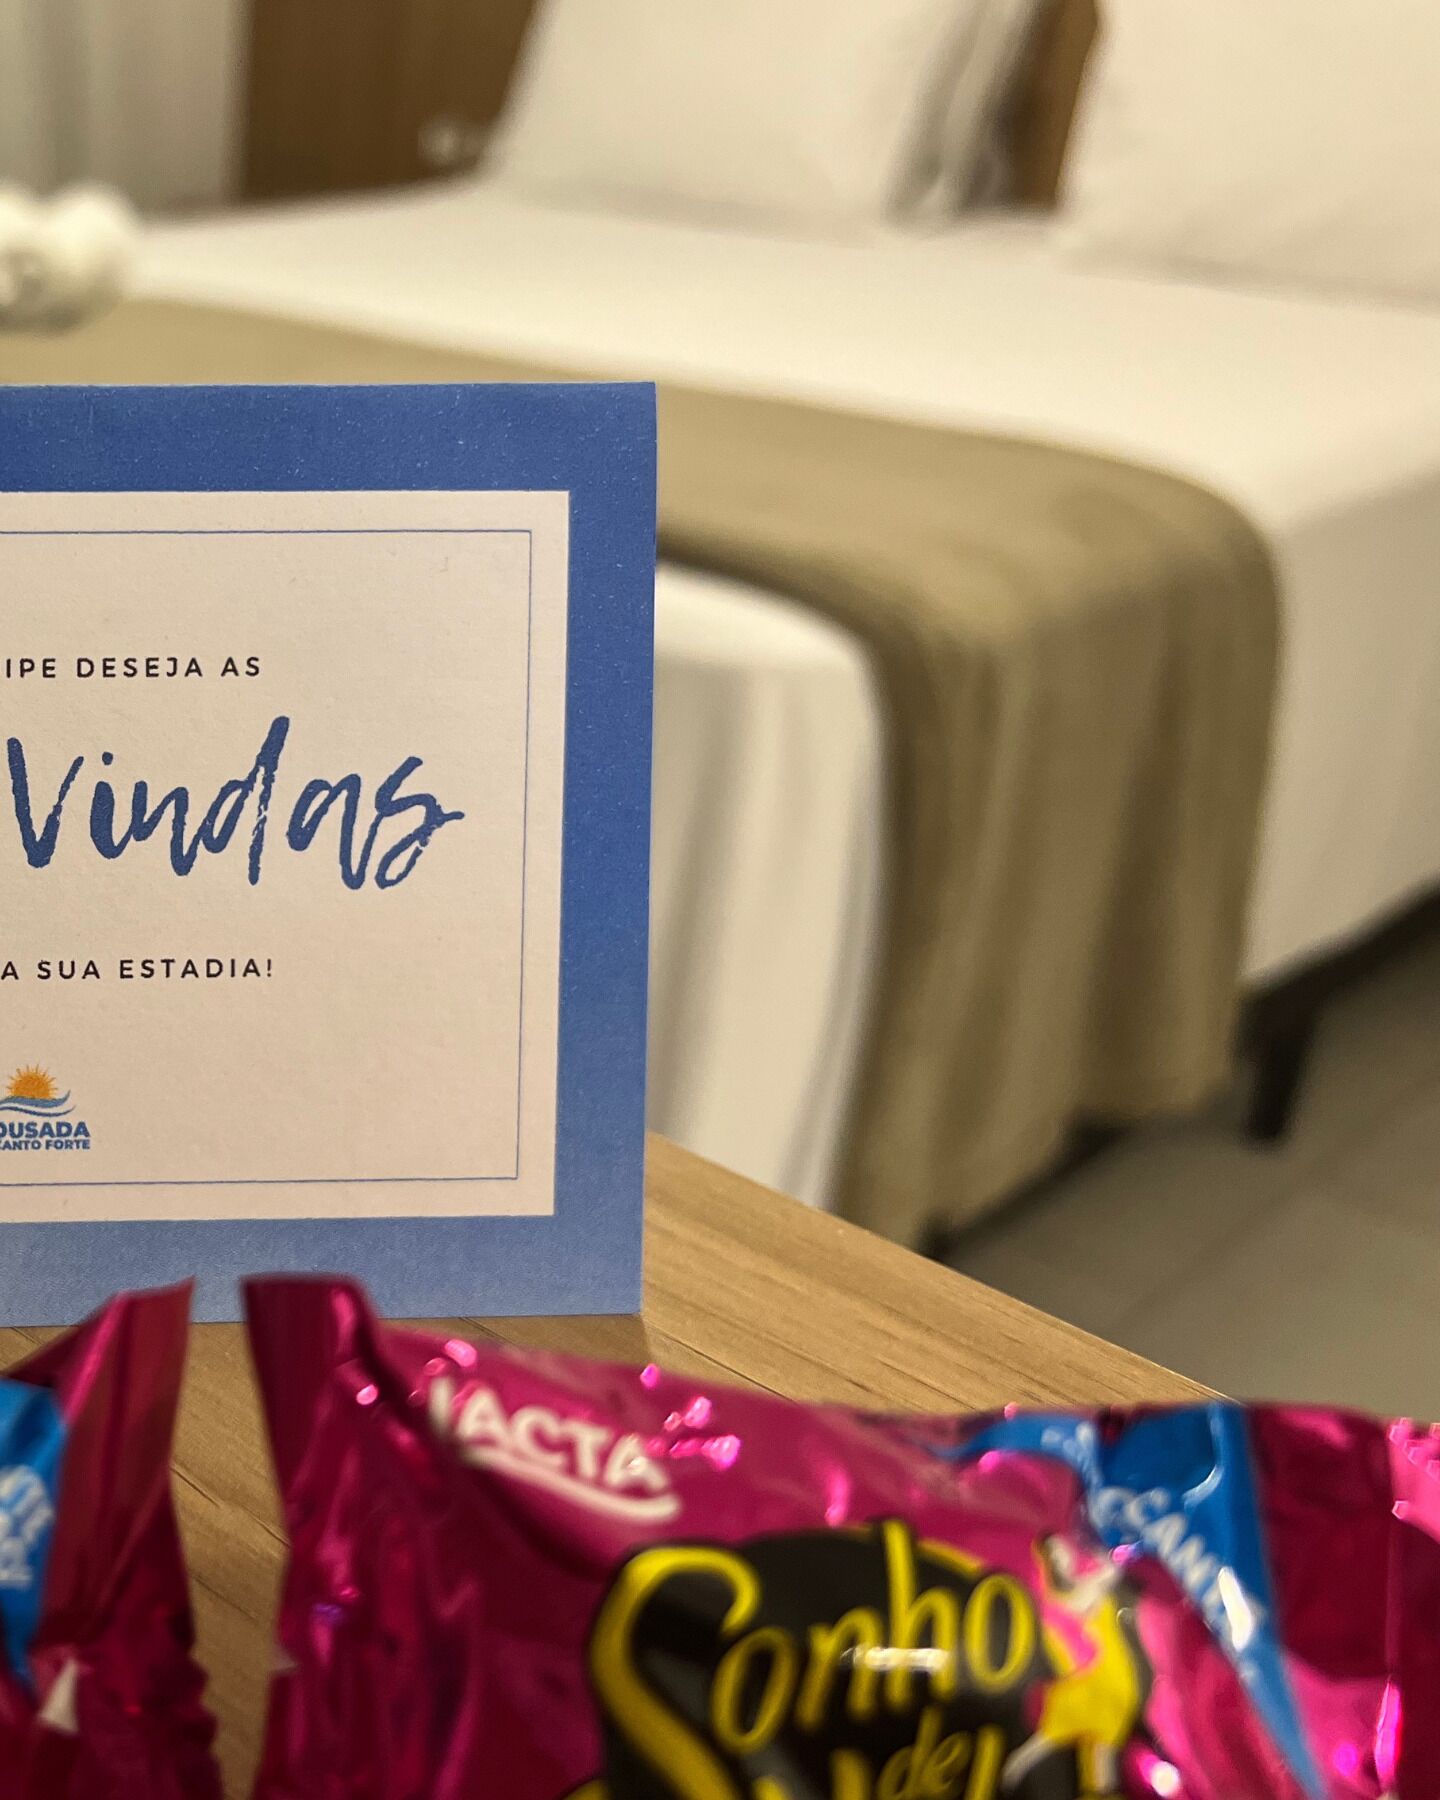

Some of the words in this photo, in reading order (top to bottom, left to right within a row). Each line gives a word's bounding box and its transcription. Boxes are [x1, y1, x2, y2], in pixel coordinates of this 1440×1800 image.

[76, 656, 204, 679] DESEJA
[220, 656, 260, 678] AS
[6, 715, 466, 891] Vindas
[0, 960, 20, 981] A
[36, 959, 101, 981] SUA
[119, 958, 272, 980] ESTADIA!
[45, 1139, 90, 1150] FORTE
[591, 1516, 1036, 1800] Sonho
[876, 1704, 973, 1800] de
